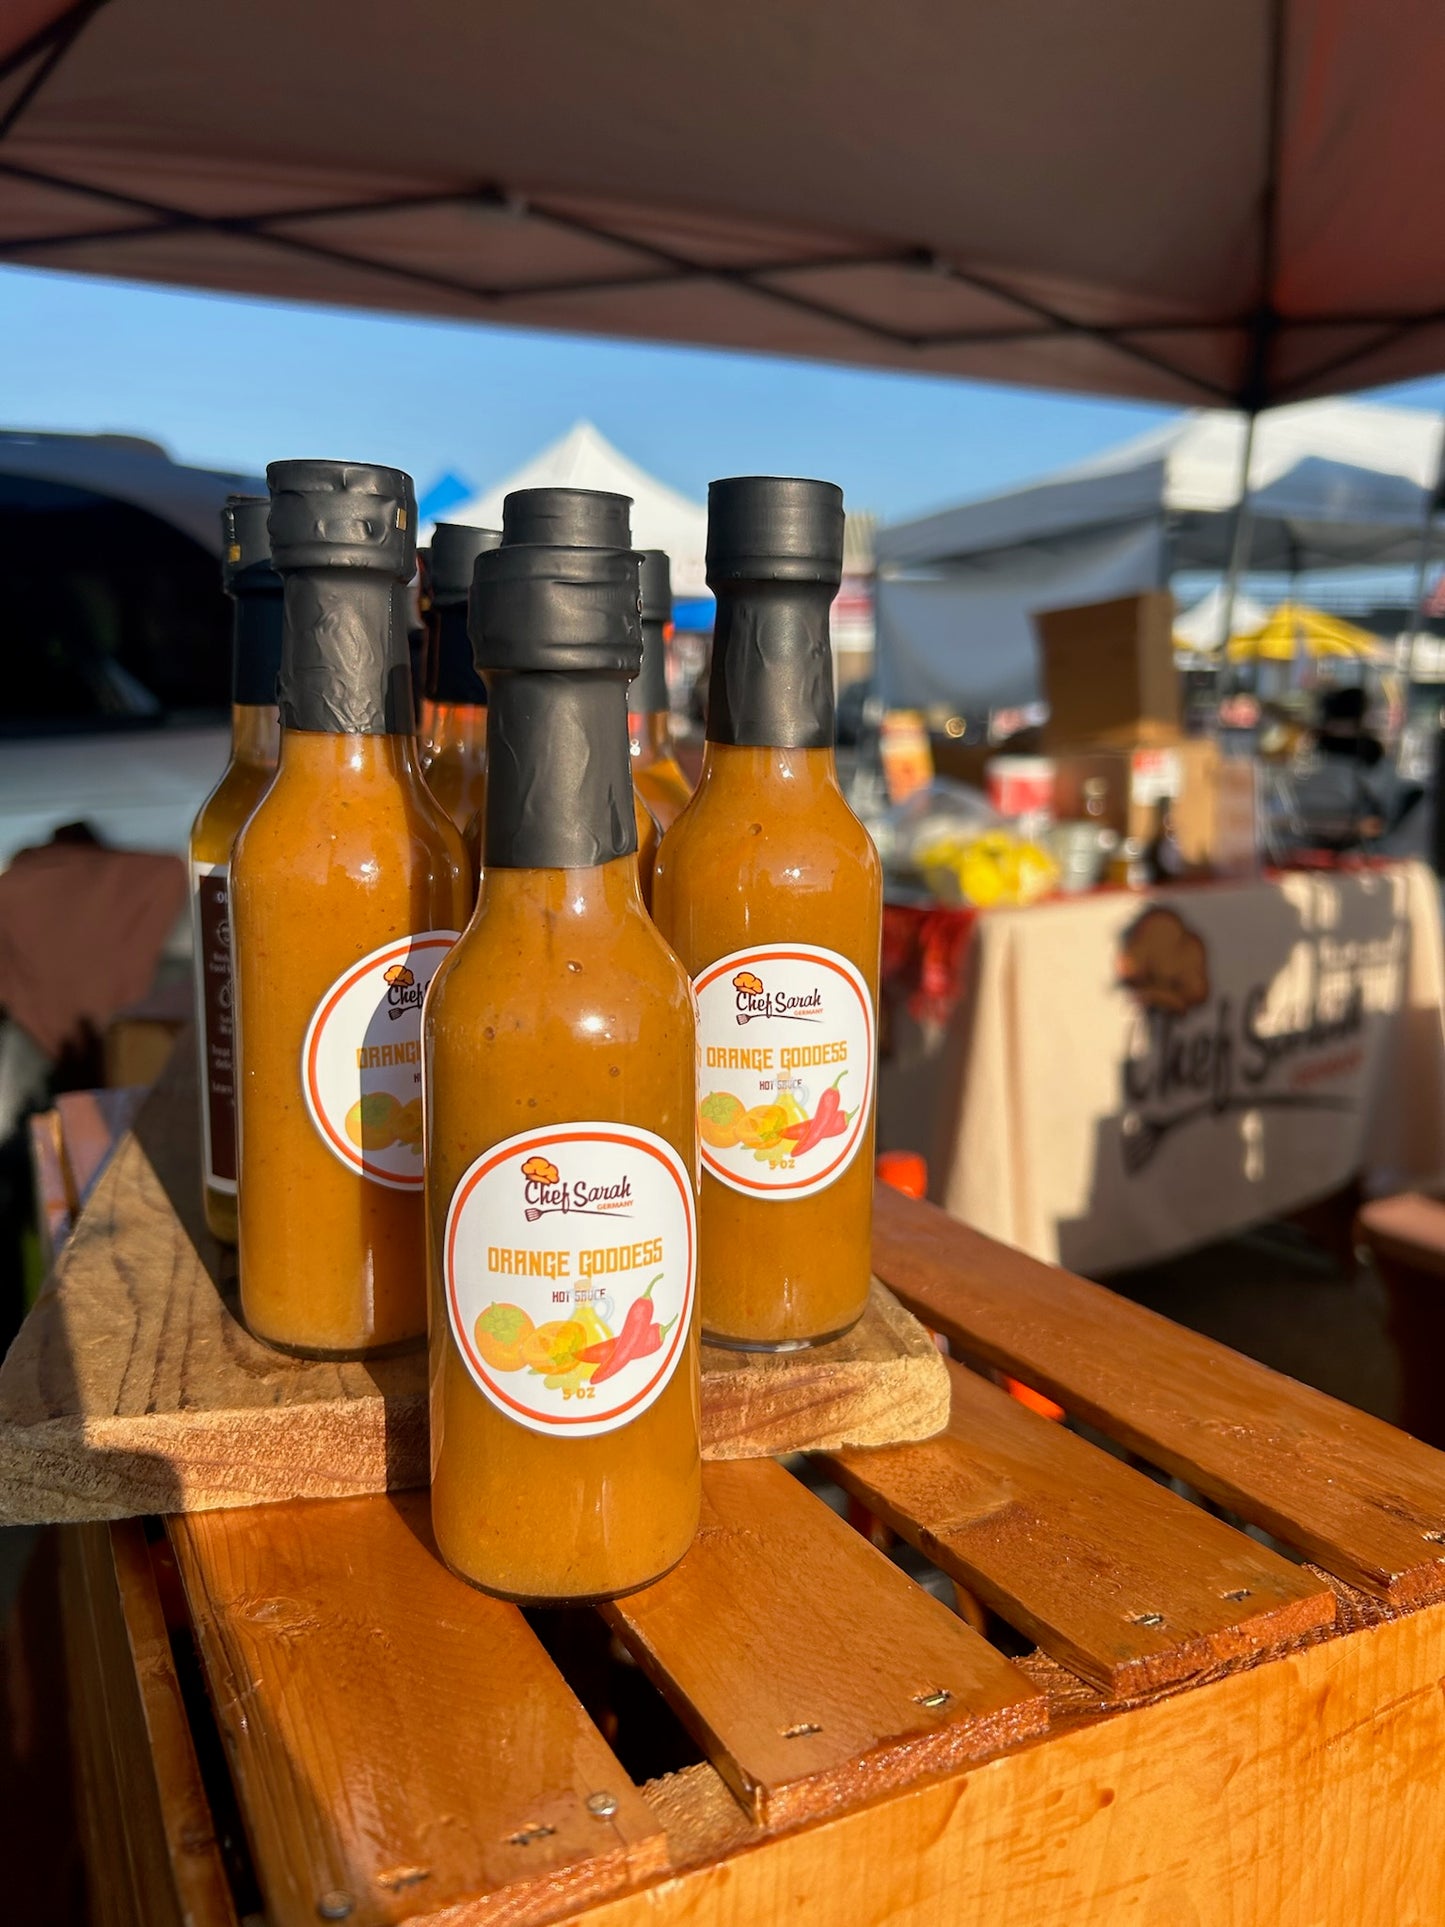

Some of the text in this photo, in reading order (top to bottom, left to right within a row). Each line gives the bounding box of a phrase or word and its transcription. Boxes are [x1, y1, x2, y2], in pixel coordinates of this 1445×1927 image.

[736, 988, 821, 1018] Chef Sarah
[793, 1008, 824, 1016] GERMANY
[706, 1040, 848, 1072] ORANGE GODDESS
[759, 1078, 802, 1090] HOT SAUCE
[525, 1175, 632, 1214] Chef Sarah
[597, 1199, 634, 1211] GERMANY
[487, 1237, 663, 1280] ORANGE GODDESS
[552, 1288, 606, 1303] HOT SAUCE
